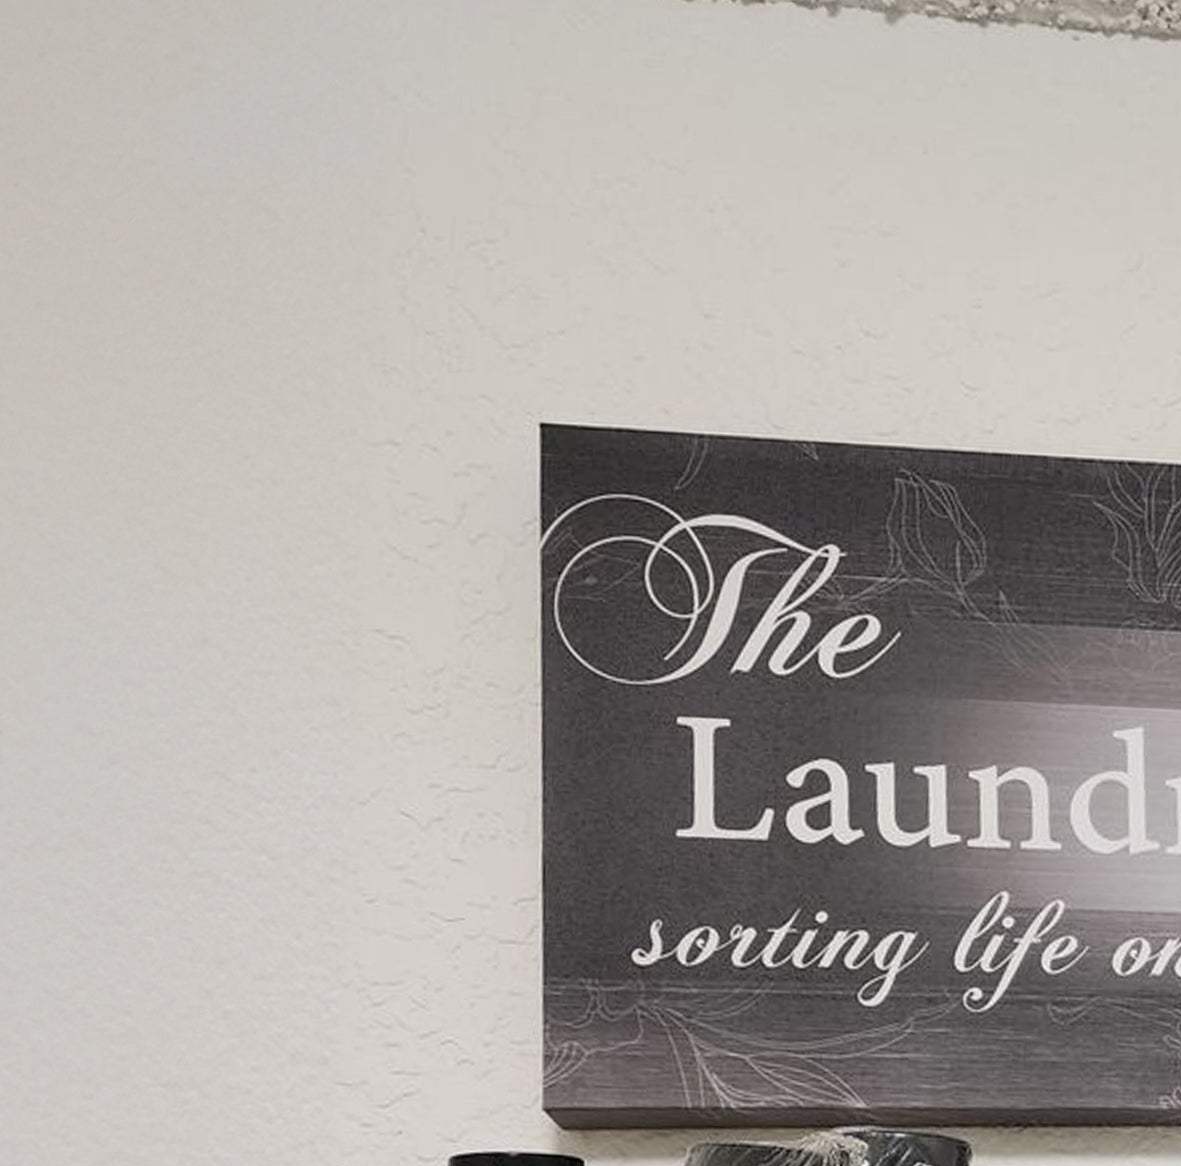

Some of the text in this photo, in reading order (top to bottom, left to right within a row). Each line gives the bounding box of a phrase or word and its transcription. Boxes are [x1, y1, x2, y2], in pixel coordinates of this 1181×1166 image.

[541, 494, 901, 685] The
[631, 908, 930, 1008] sorting
[954, 890, 1089, 1012] life
